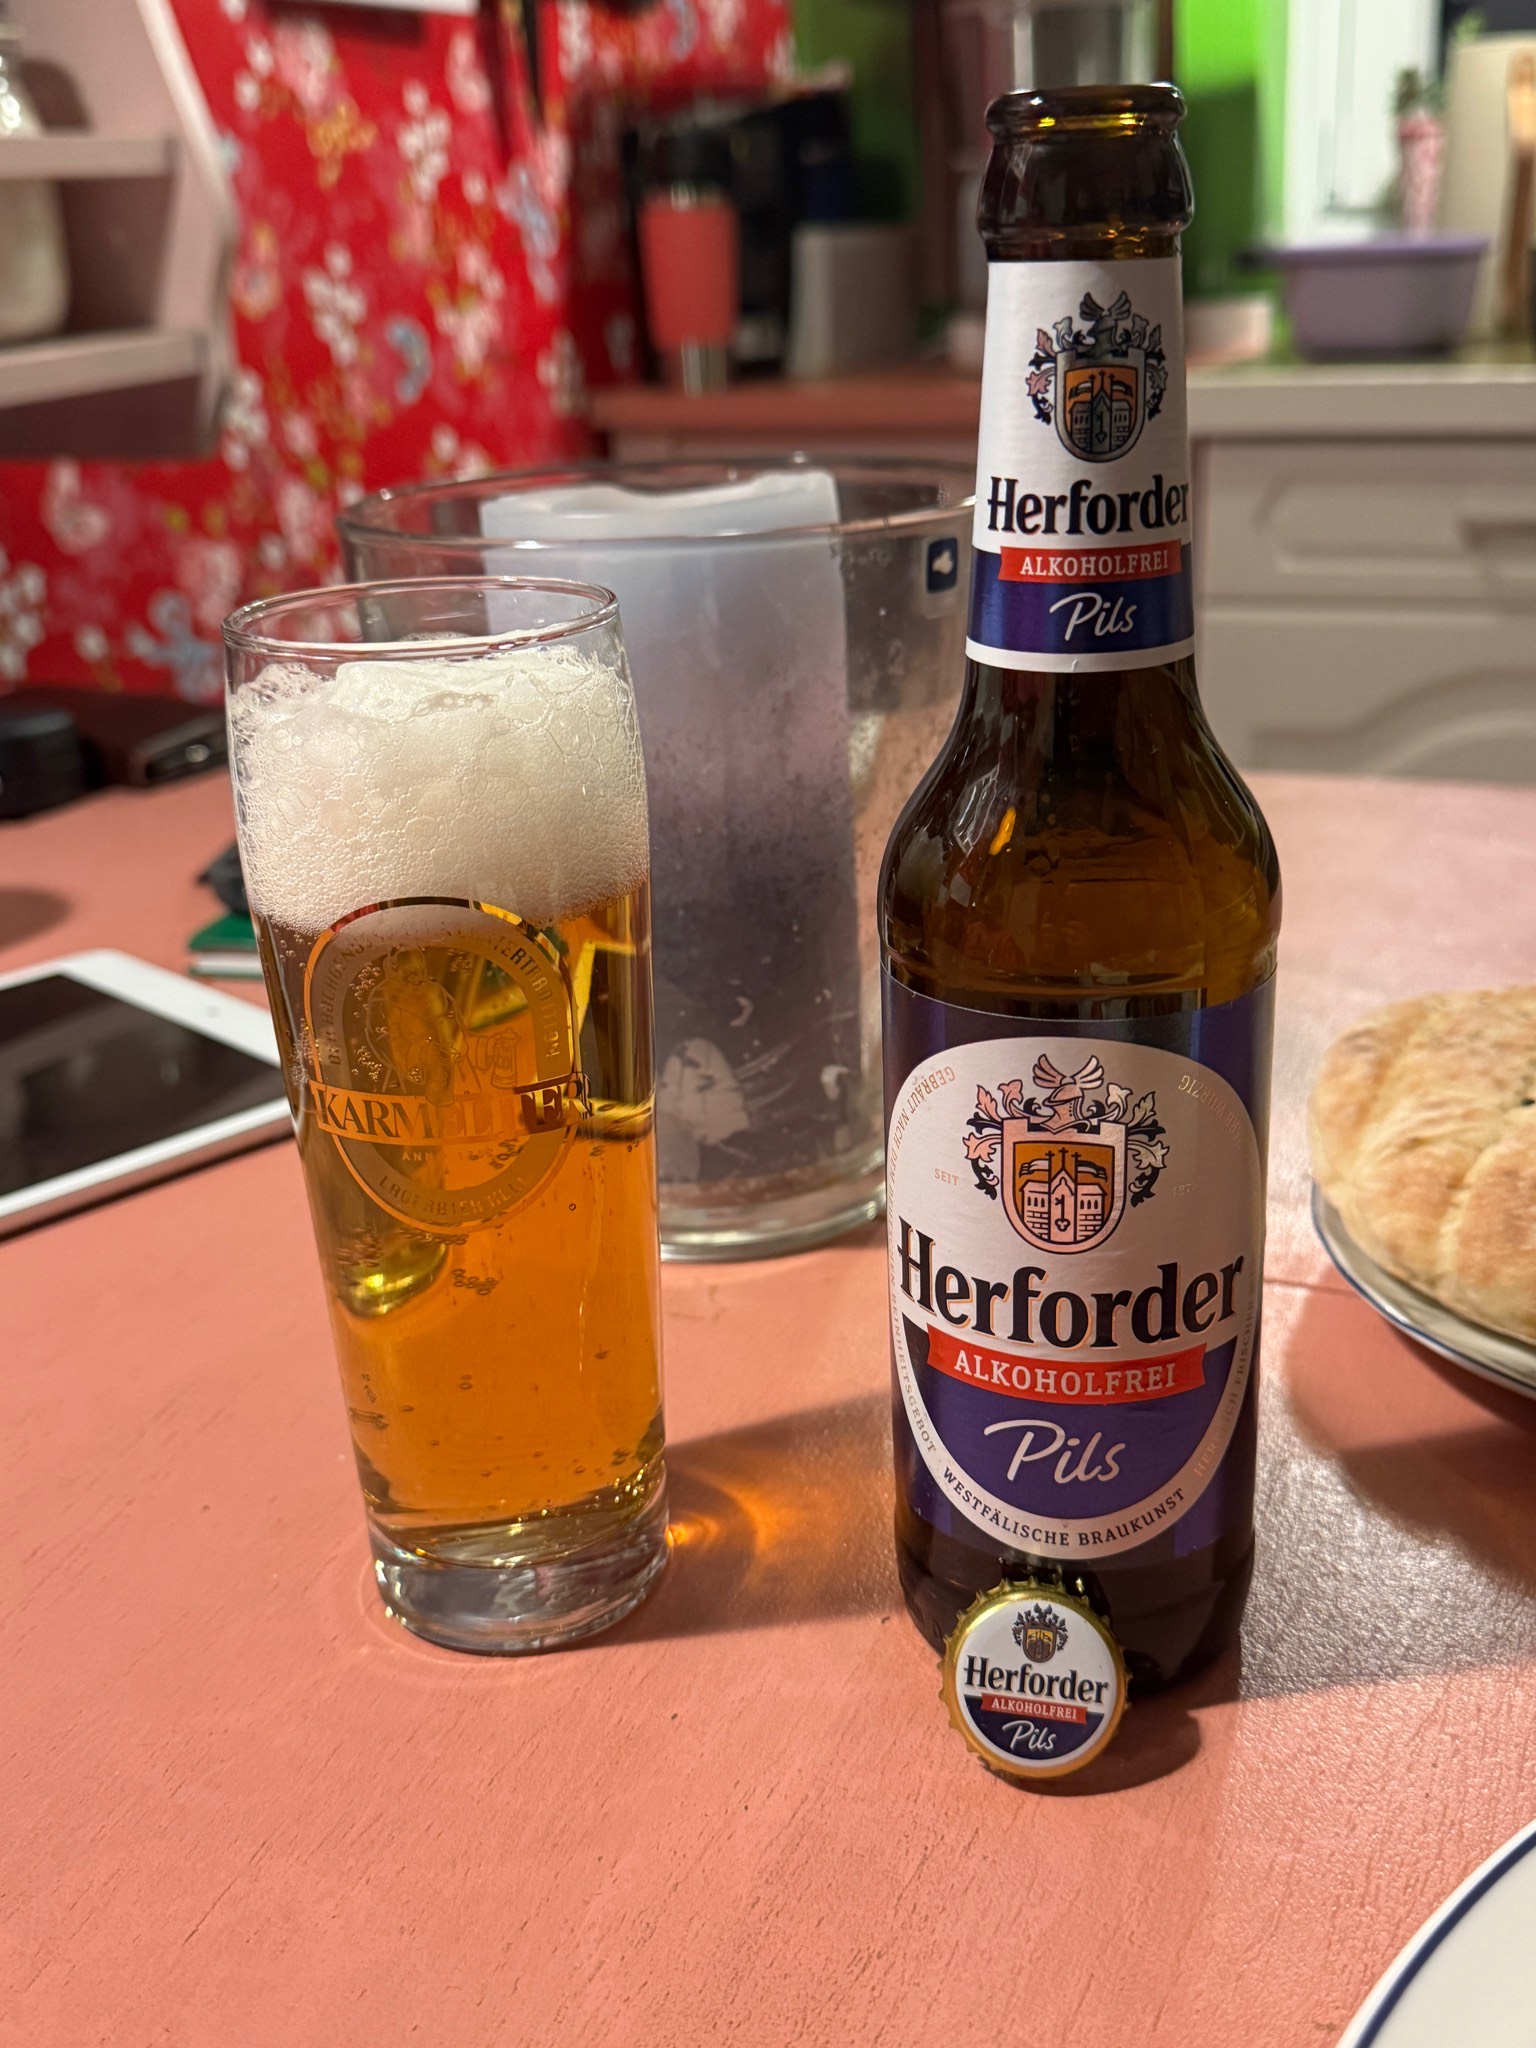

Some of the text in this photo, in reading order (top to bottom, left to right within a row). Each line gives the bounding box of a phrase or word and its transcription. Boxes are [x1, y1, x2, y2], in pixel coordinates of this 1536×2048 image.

[987, 474, 1189, 535] Herforder
[1019, 550, 1169, 577] ALKOHOLFREI
[1049, 592, 1138, 642] Pils
[907, 1066, 956, 1114] GEBRAUT
[893, 1108, 910, 1150] NACH
[934, 1168, 959, 1186] SEIT
[897, 1215, 1244, 1348] Herforder
[892, 1293, 937, 1453] REINHEITSGEBOT
[954, 1350, 1176, 1396] ALKOHOLFREI
[983, 1419, 1126, 1484] Pils
[943, 1466, 1185, 1546] WESTFÄLISCHE BRAUKUNST
[963, 1655, 1109, 1704] Herforder
[991, 1697, 1078, 1720] ALKOHOLFREI
[1002, 1720, 1057, 1751] Pils
